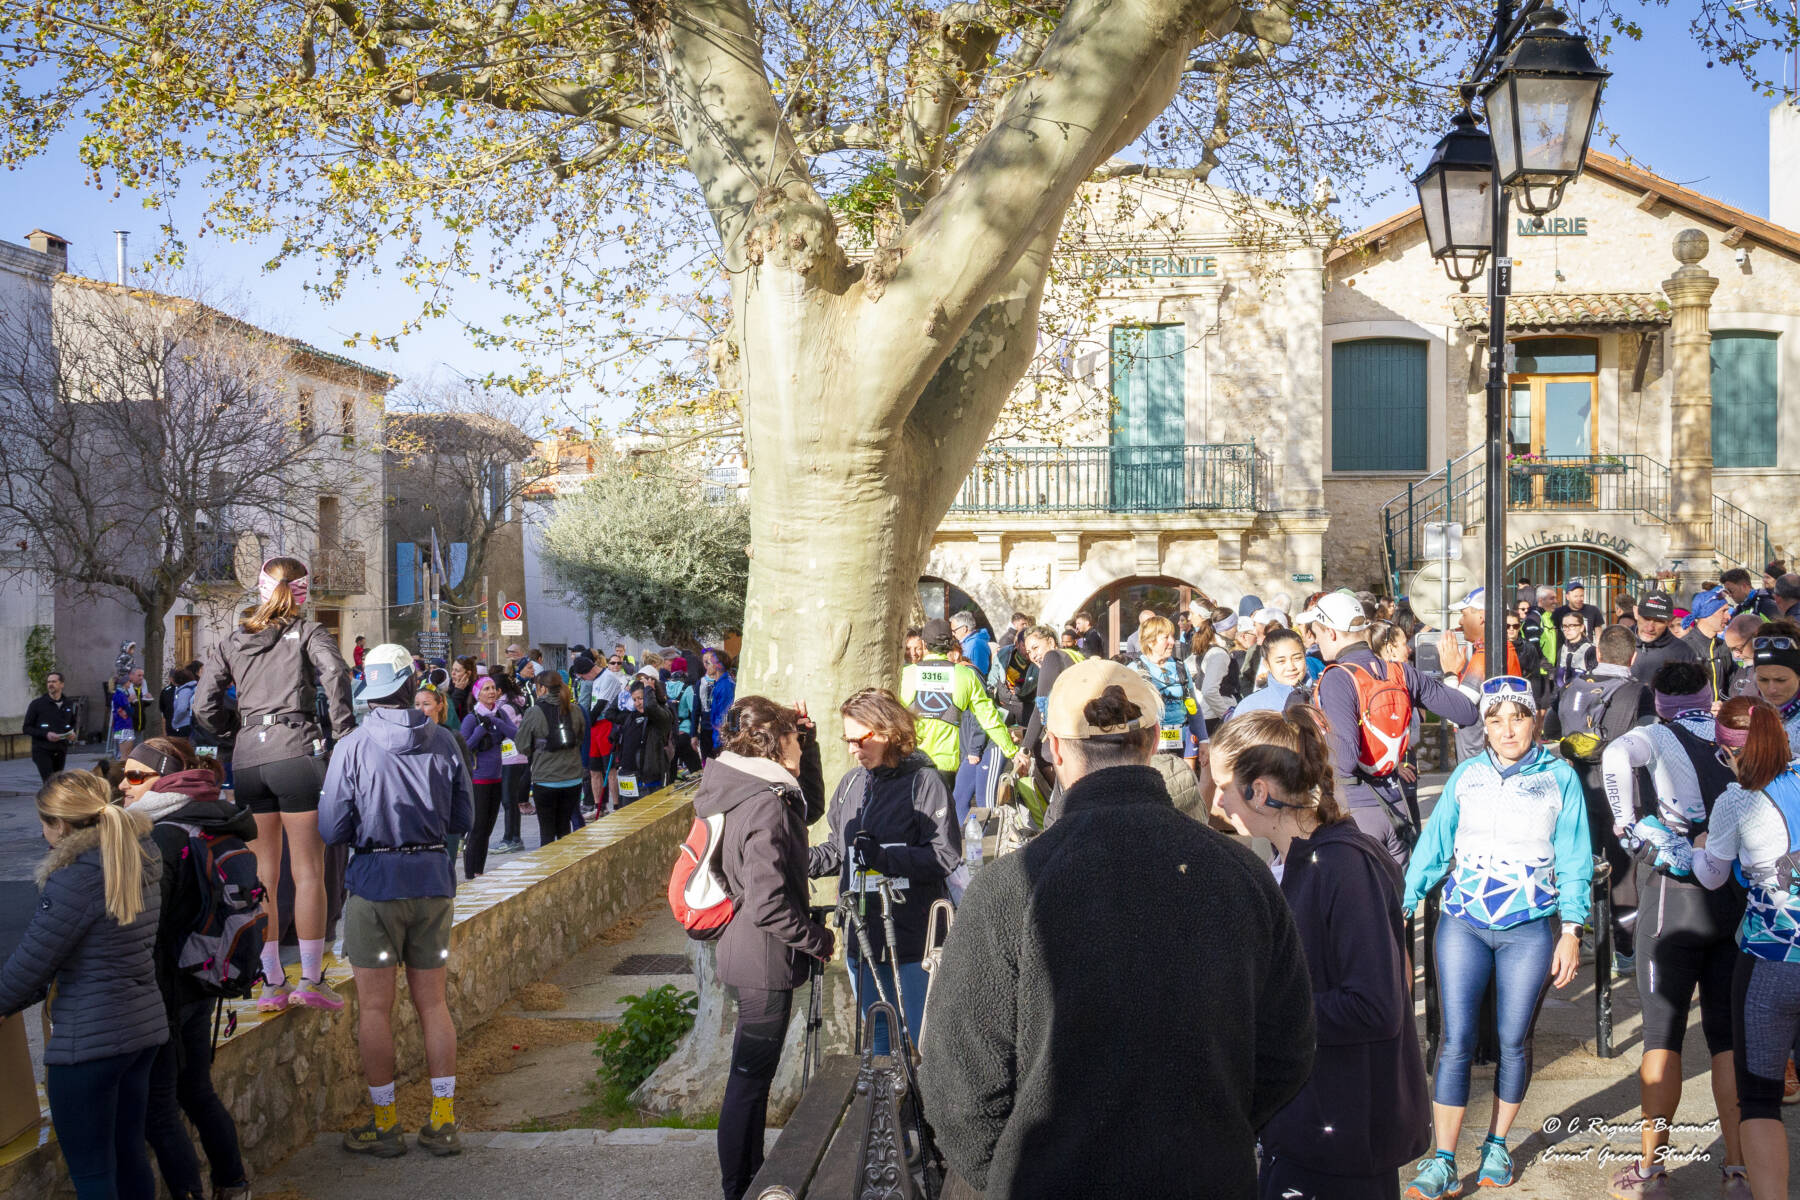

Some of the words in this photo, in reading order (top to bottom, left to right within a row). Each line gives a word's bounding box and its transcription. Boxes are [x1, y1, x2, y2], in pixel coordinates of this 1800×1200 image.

[1517, 217, 1587, 236] MAIRIE
[1506, 529, 1550, 559] SALLE
[921, 671, 942, 681] 3316
